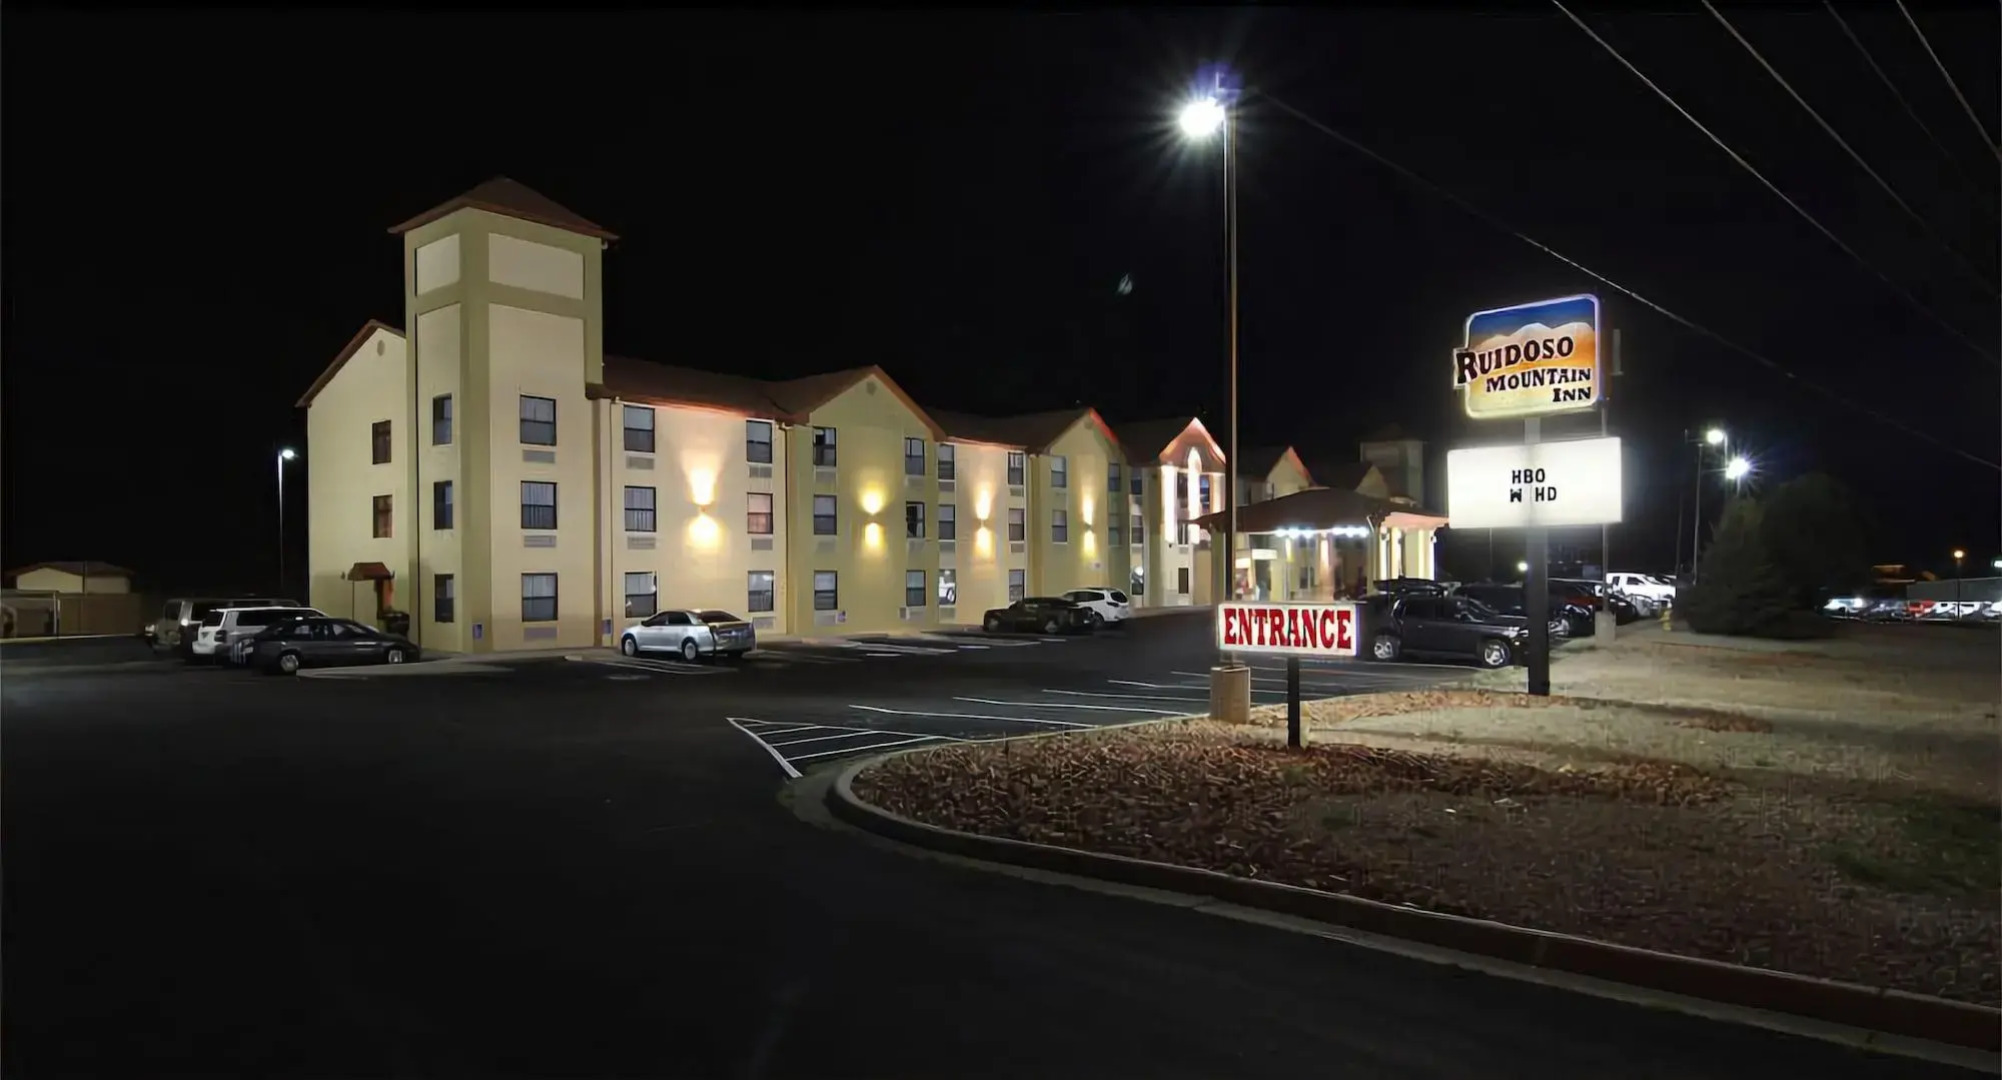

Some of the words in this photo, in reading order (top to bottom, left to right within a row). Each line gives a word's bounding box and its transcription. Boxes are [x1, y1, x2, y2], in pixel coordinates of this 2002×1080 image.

[1456, 336, 1574, 384] RUIDOSO
[1486, 368, 1592, 393] MOUNTAIN
[1553, 387, 1592, 403] INN
[1512, 468, 1546, 484] HBO
[1535, 487, 1557, 502] HD
[1224, 608, 1352, 650] ENTRANCE
